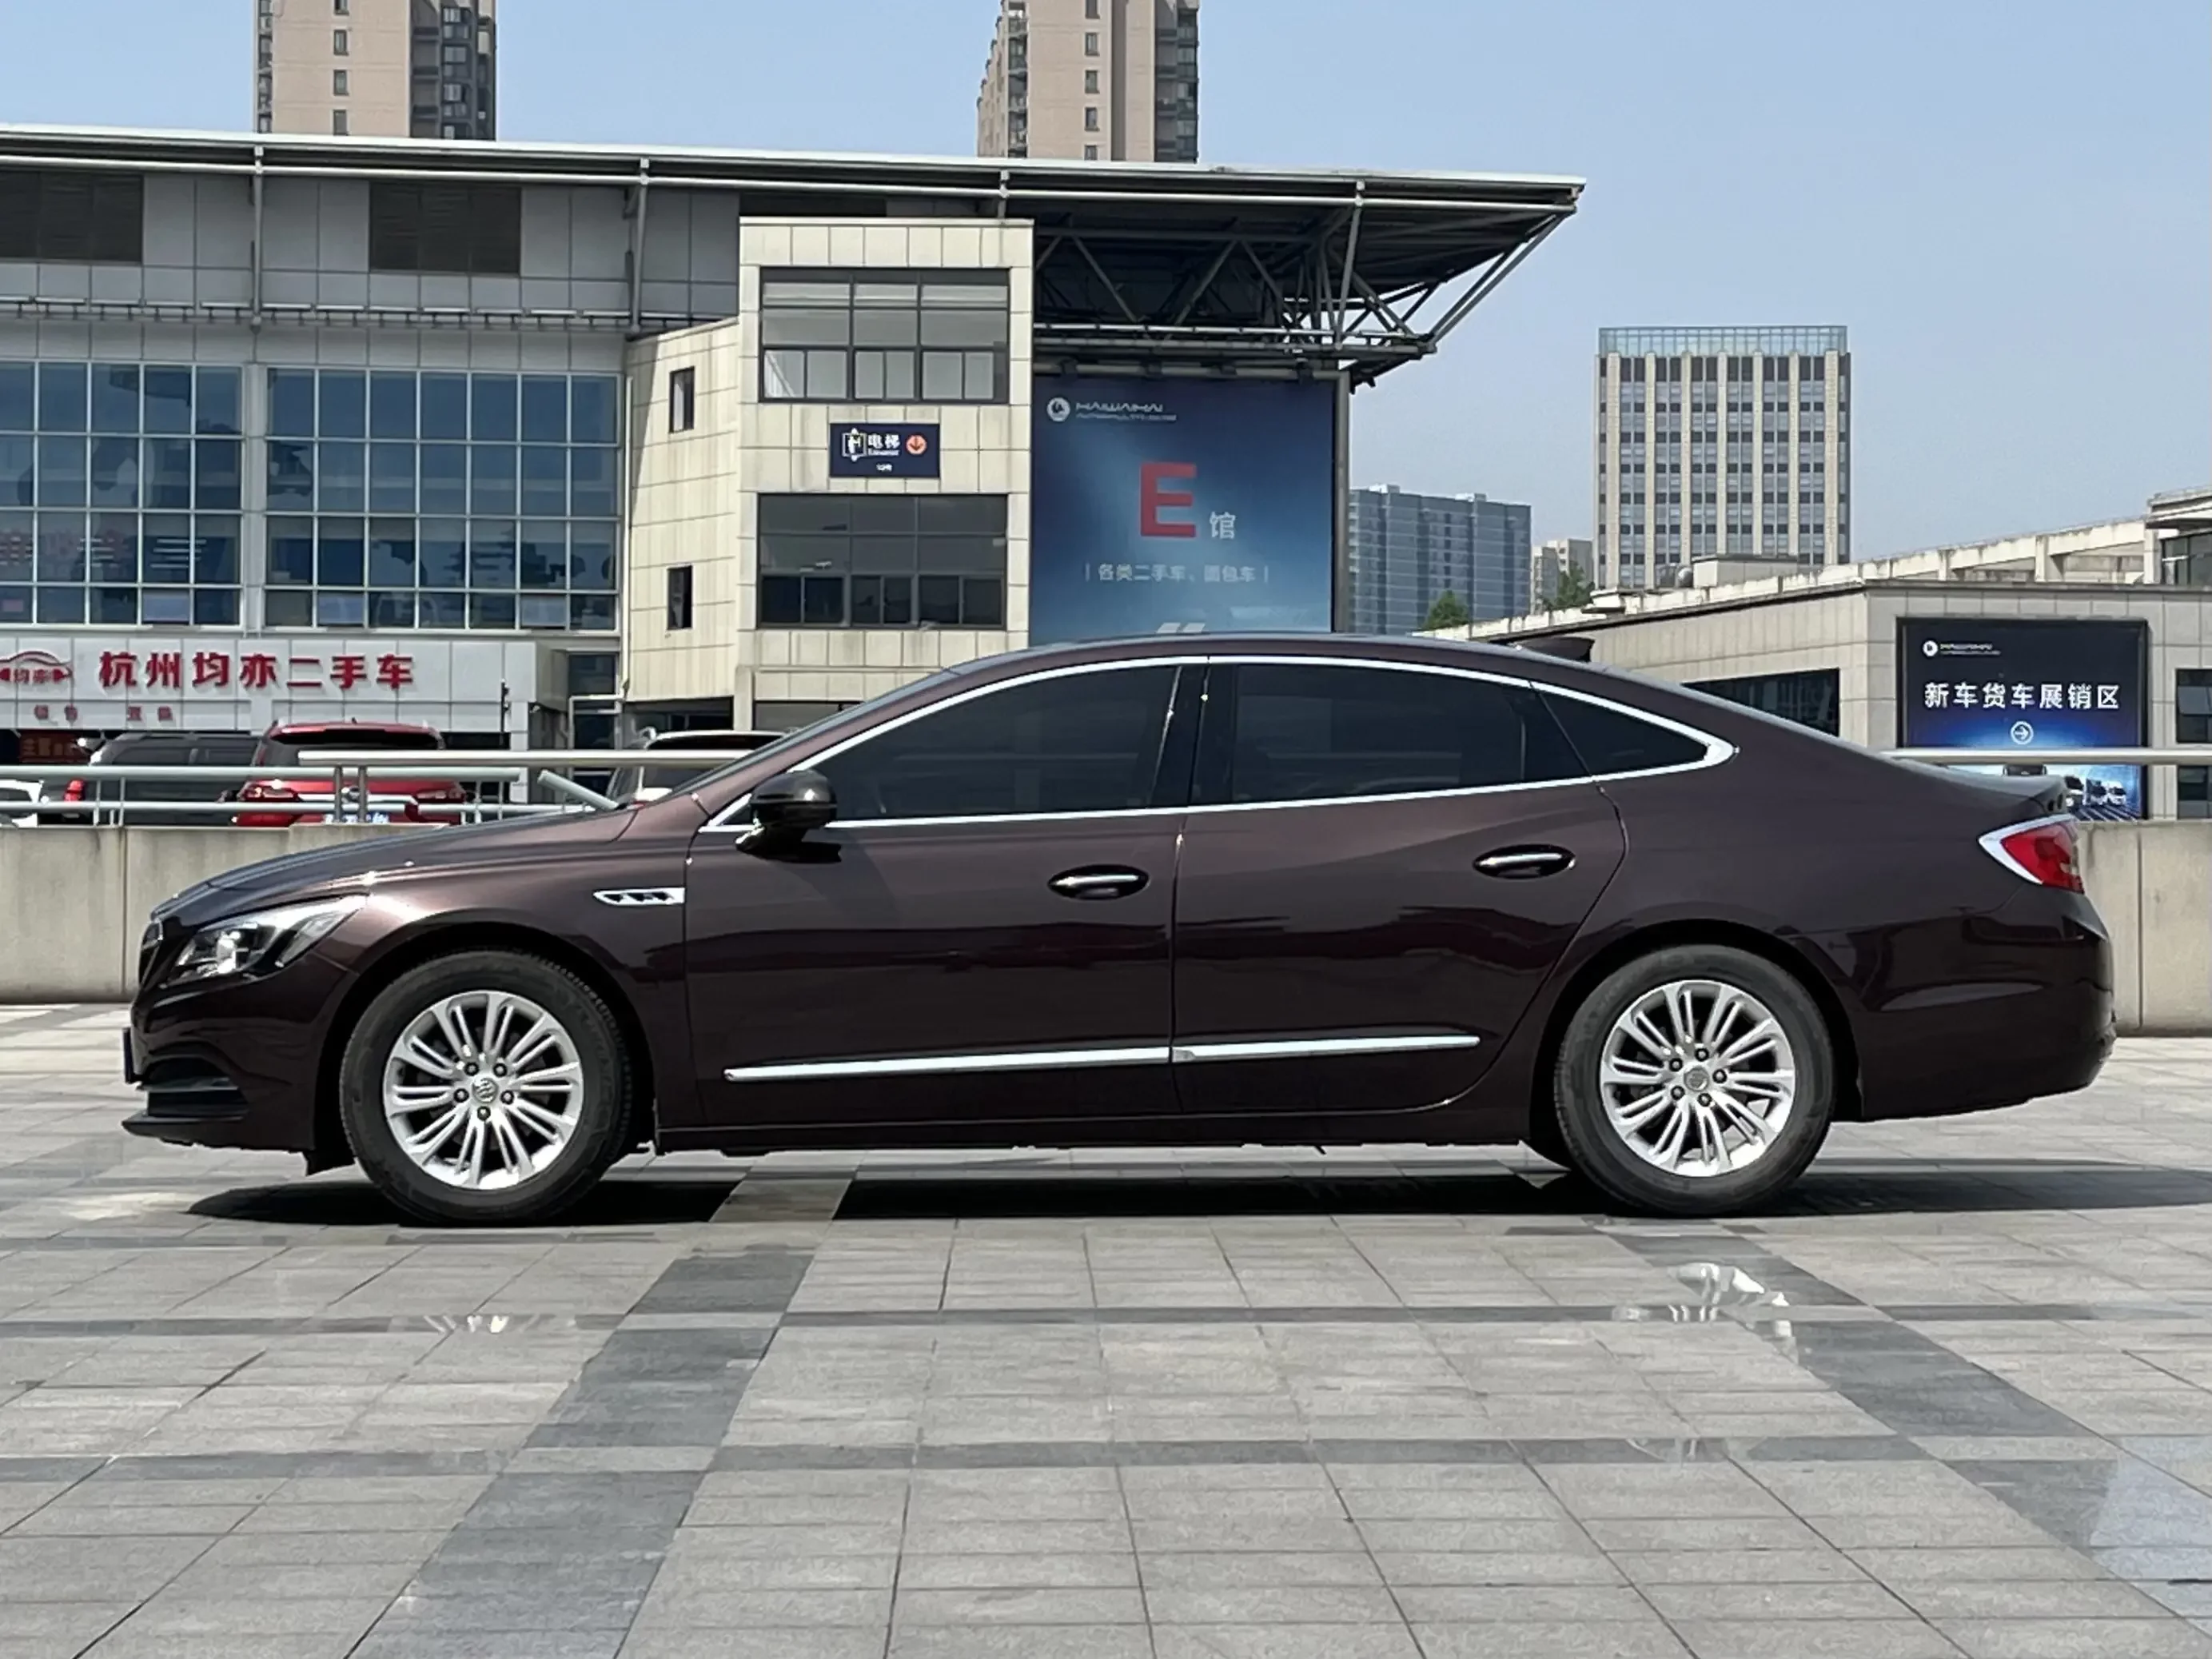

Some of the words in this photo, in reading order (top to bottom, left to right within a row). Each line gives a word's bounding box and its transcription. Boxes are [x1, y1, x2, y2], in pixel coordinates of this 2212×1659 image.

[1140, 462, 1197, 538] E
[1210, 511, 1237, 540] 馆
[98, 651, 414, 689] 杭州均亦二手车
[1924, 682, 2120, 709] 新车货车展销区
